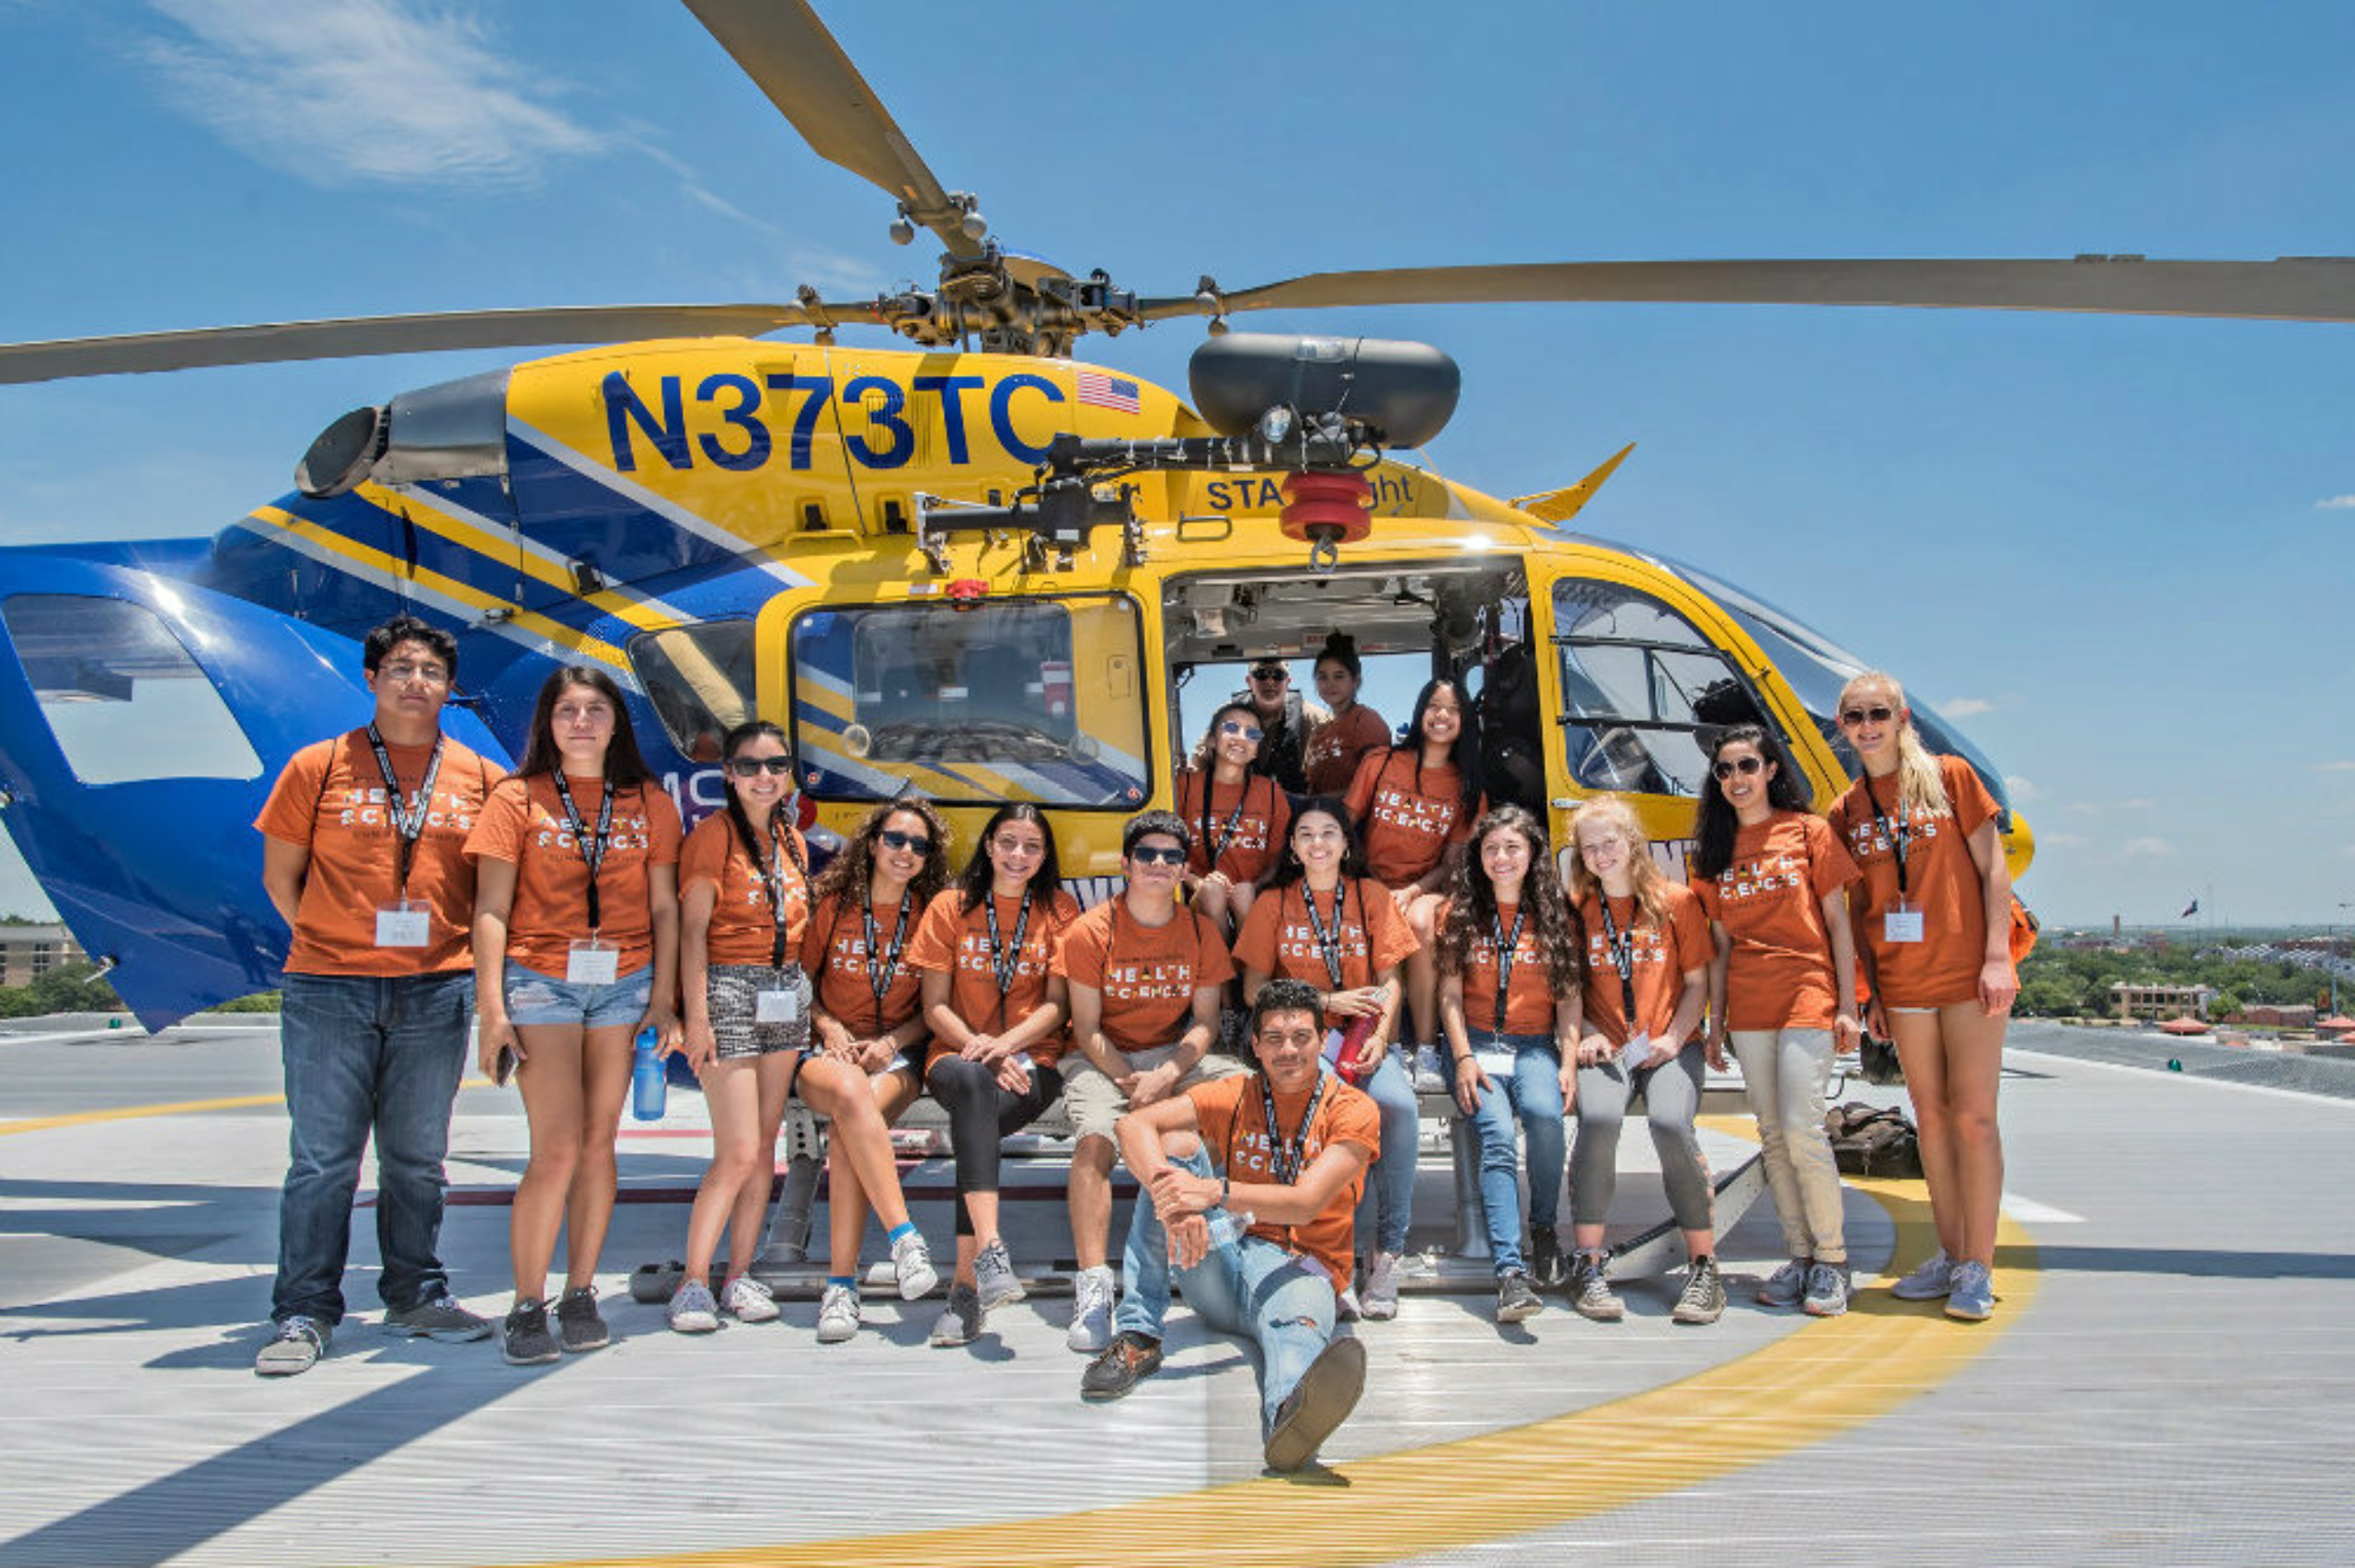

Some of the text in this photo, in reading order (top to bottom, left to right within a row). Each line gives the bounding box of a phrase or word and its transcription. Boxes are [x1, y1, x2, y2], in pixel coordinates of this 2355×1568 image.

[602, 371, 1065, 472] N373TC
[1207, 476, 1284, 509] STA
[343, 786, 467, 808] HELTH
[1718, 872, 1800, 899] CIENCES
[1281, 943, 1367, 959] SCIECES
[1588, 948, 1666, 967] CIECES
[1107, 963, 1191, 983] HEALTH
[1104, 983, 1192, 1001] SCIENCES
